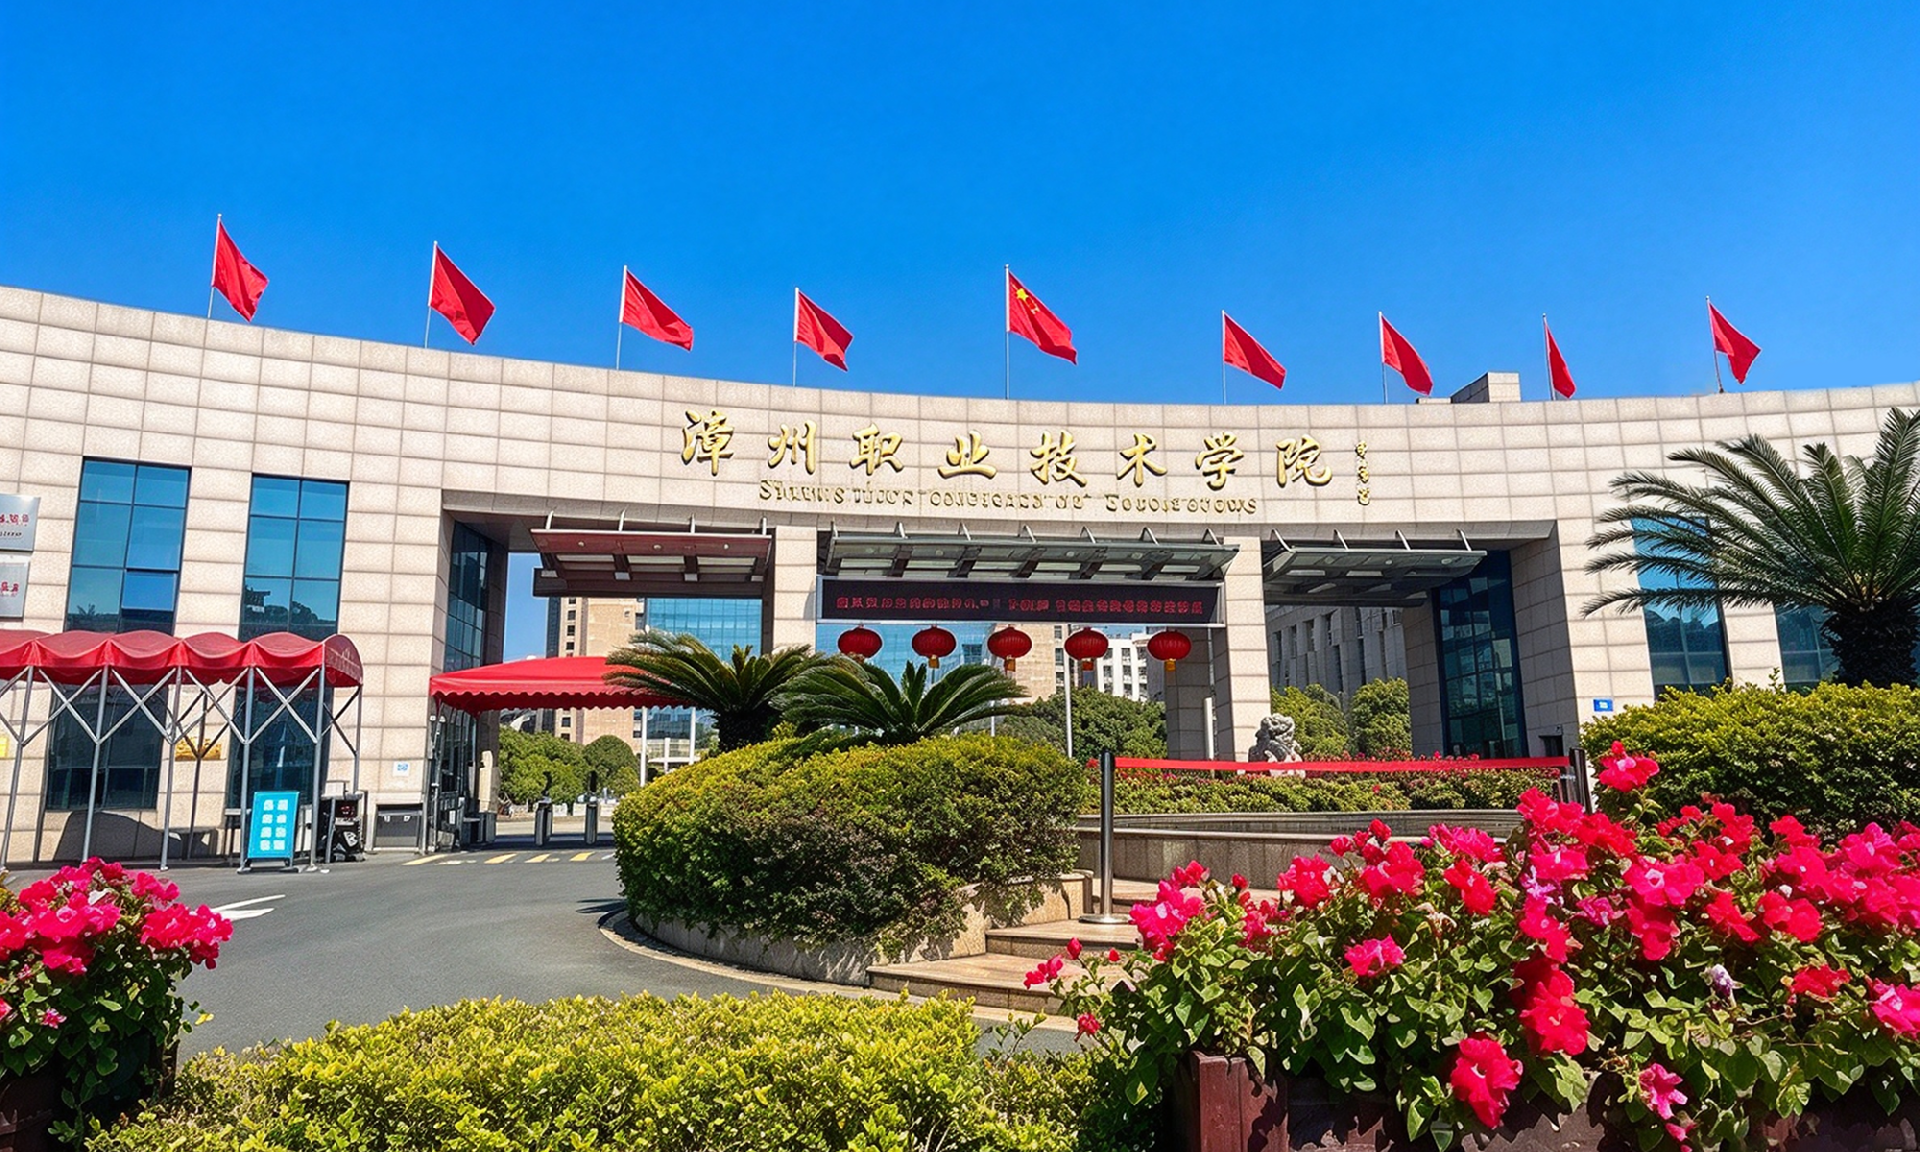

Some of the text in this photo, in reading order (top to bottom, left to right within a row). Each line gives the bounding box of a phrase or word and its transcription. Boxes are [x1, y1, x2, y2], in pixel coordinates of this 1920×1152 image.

[681, 410, 1333, 491] 漳州职业技术学院
